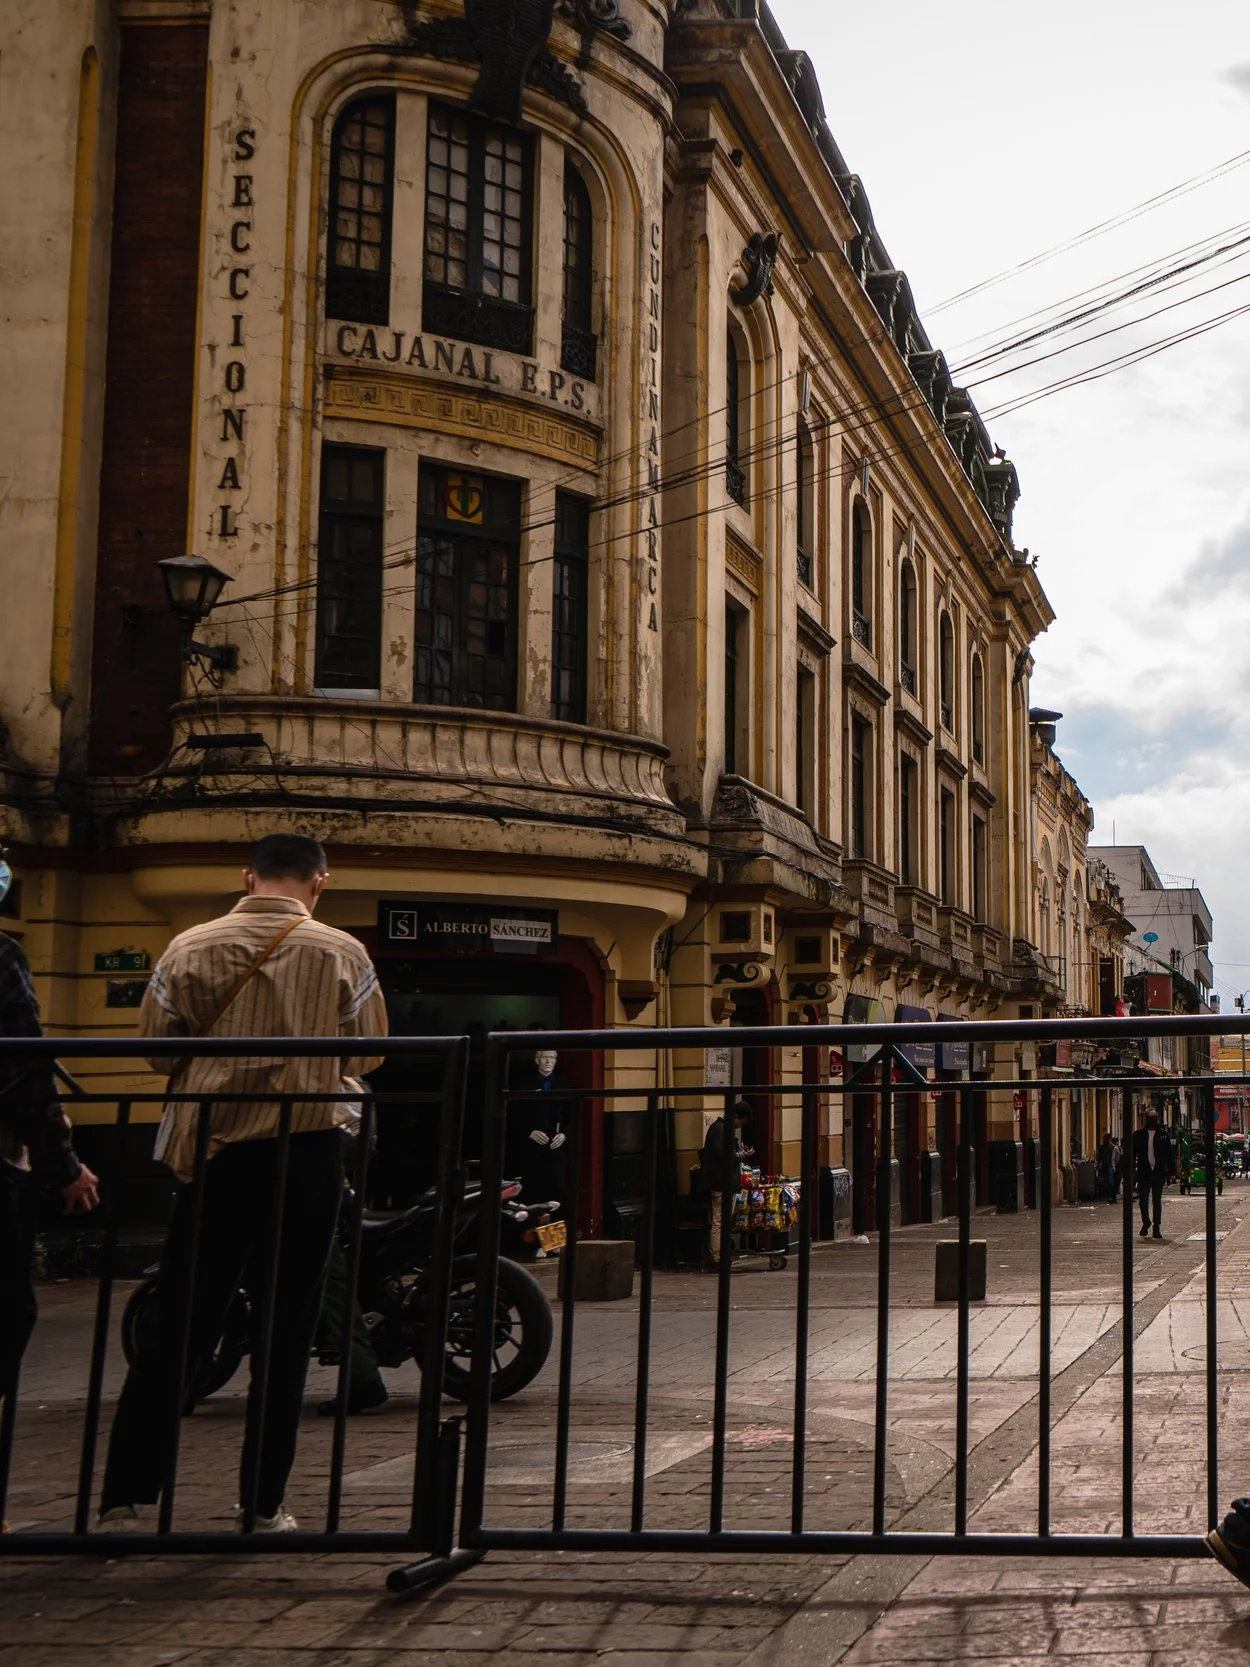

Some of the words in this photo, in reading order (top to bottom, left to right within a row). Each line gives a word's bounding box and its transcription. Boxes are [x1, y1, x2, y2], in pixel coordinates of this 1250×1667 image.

[217, 129, 256, 538] SECCIONAL
[336, 324, 500, 385] CAJANAL
[520, 360, 593, 416] E.P.S.
[646, 222, 662, 633] CUNDINAMARCA
[423, 922, 488, 935] ALBERTO
[493, 922, 549, 938] SÁNCHEZ
